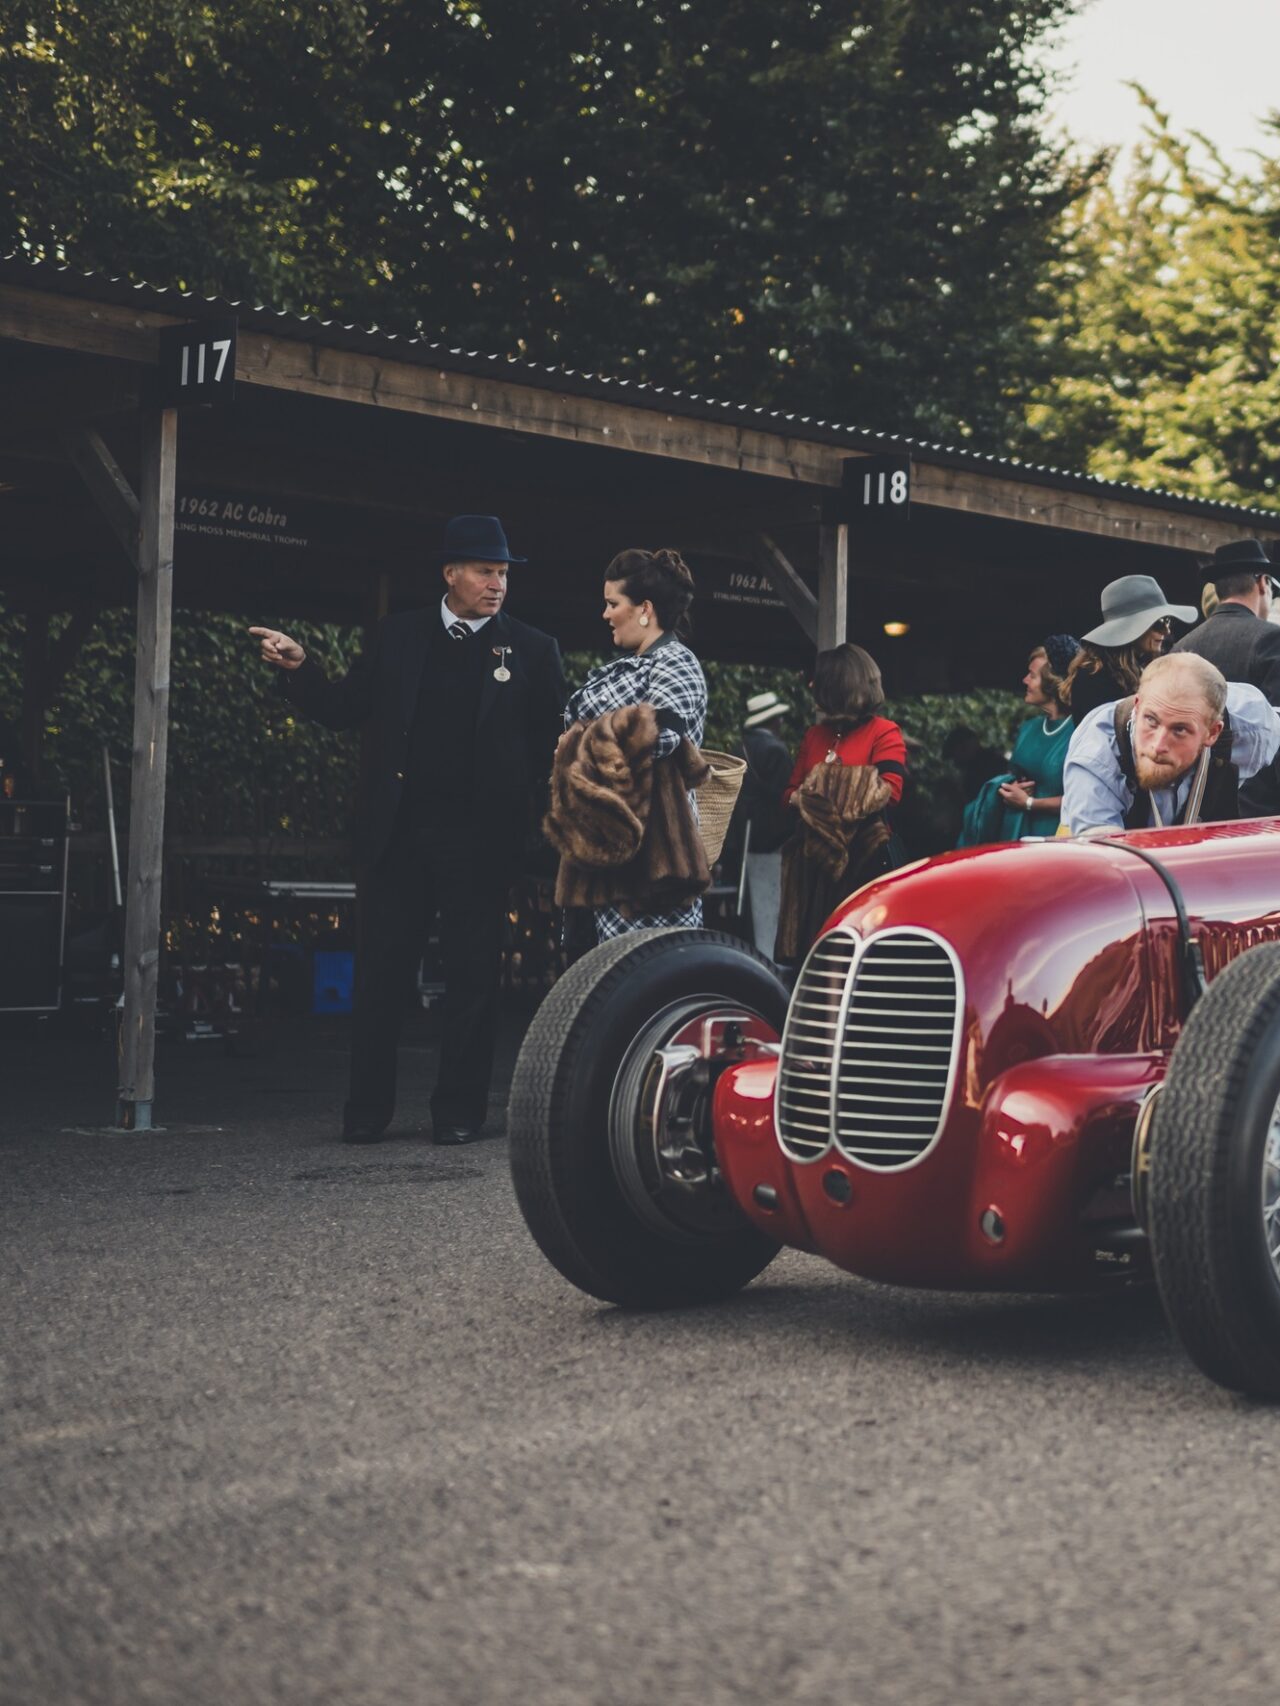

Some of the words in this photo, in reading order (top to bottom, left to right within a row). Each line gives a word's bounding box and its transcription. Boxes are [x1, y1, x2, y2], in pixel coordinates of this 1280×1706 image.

[181, 339, 231, 386] 117
[863, 470, 907, 505] 118
[179, 496, 219, 517] 1962
[222, 501, 244, 520] AC
[247, 505, 287, 527] Cobra
[199, 525, 224, 535] MOSS
[226, 528, 271, 542] MEMORIAL
[274, 534, 308, 546] TROPHY
[729, 572, 757, 588] 1962
